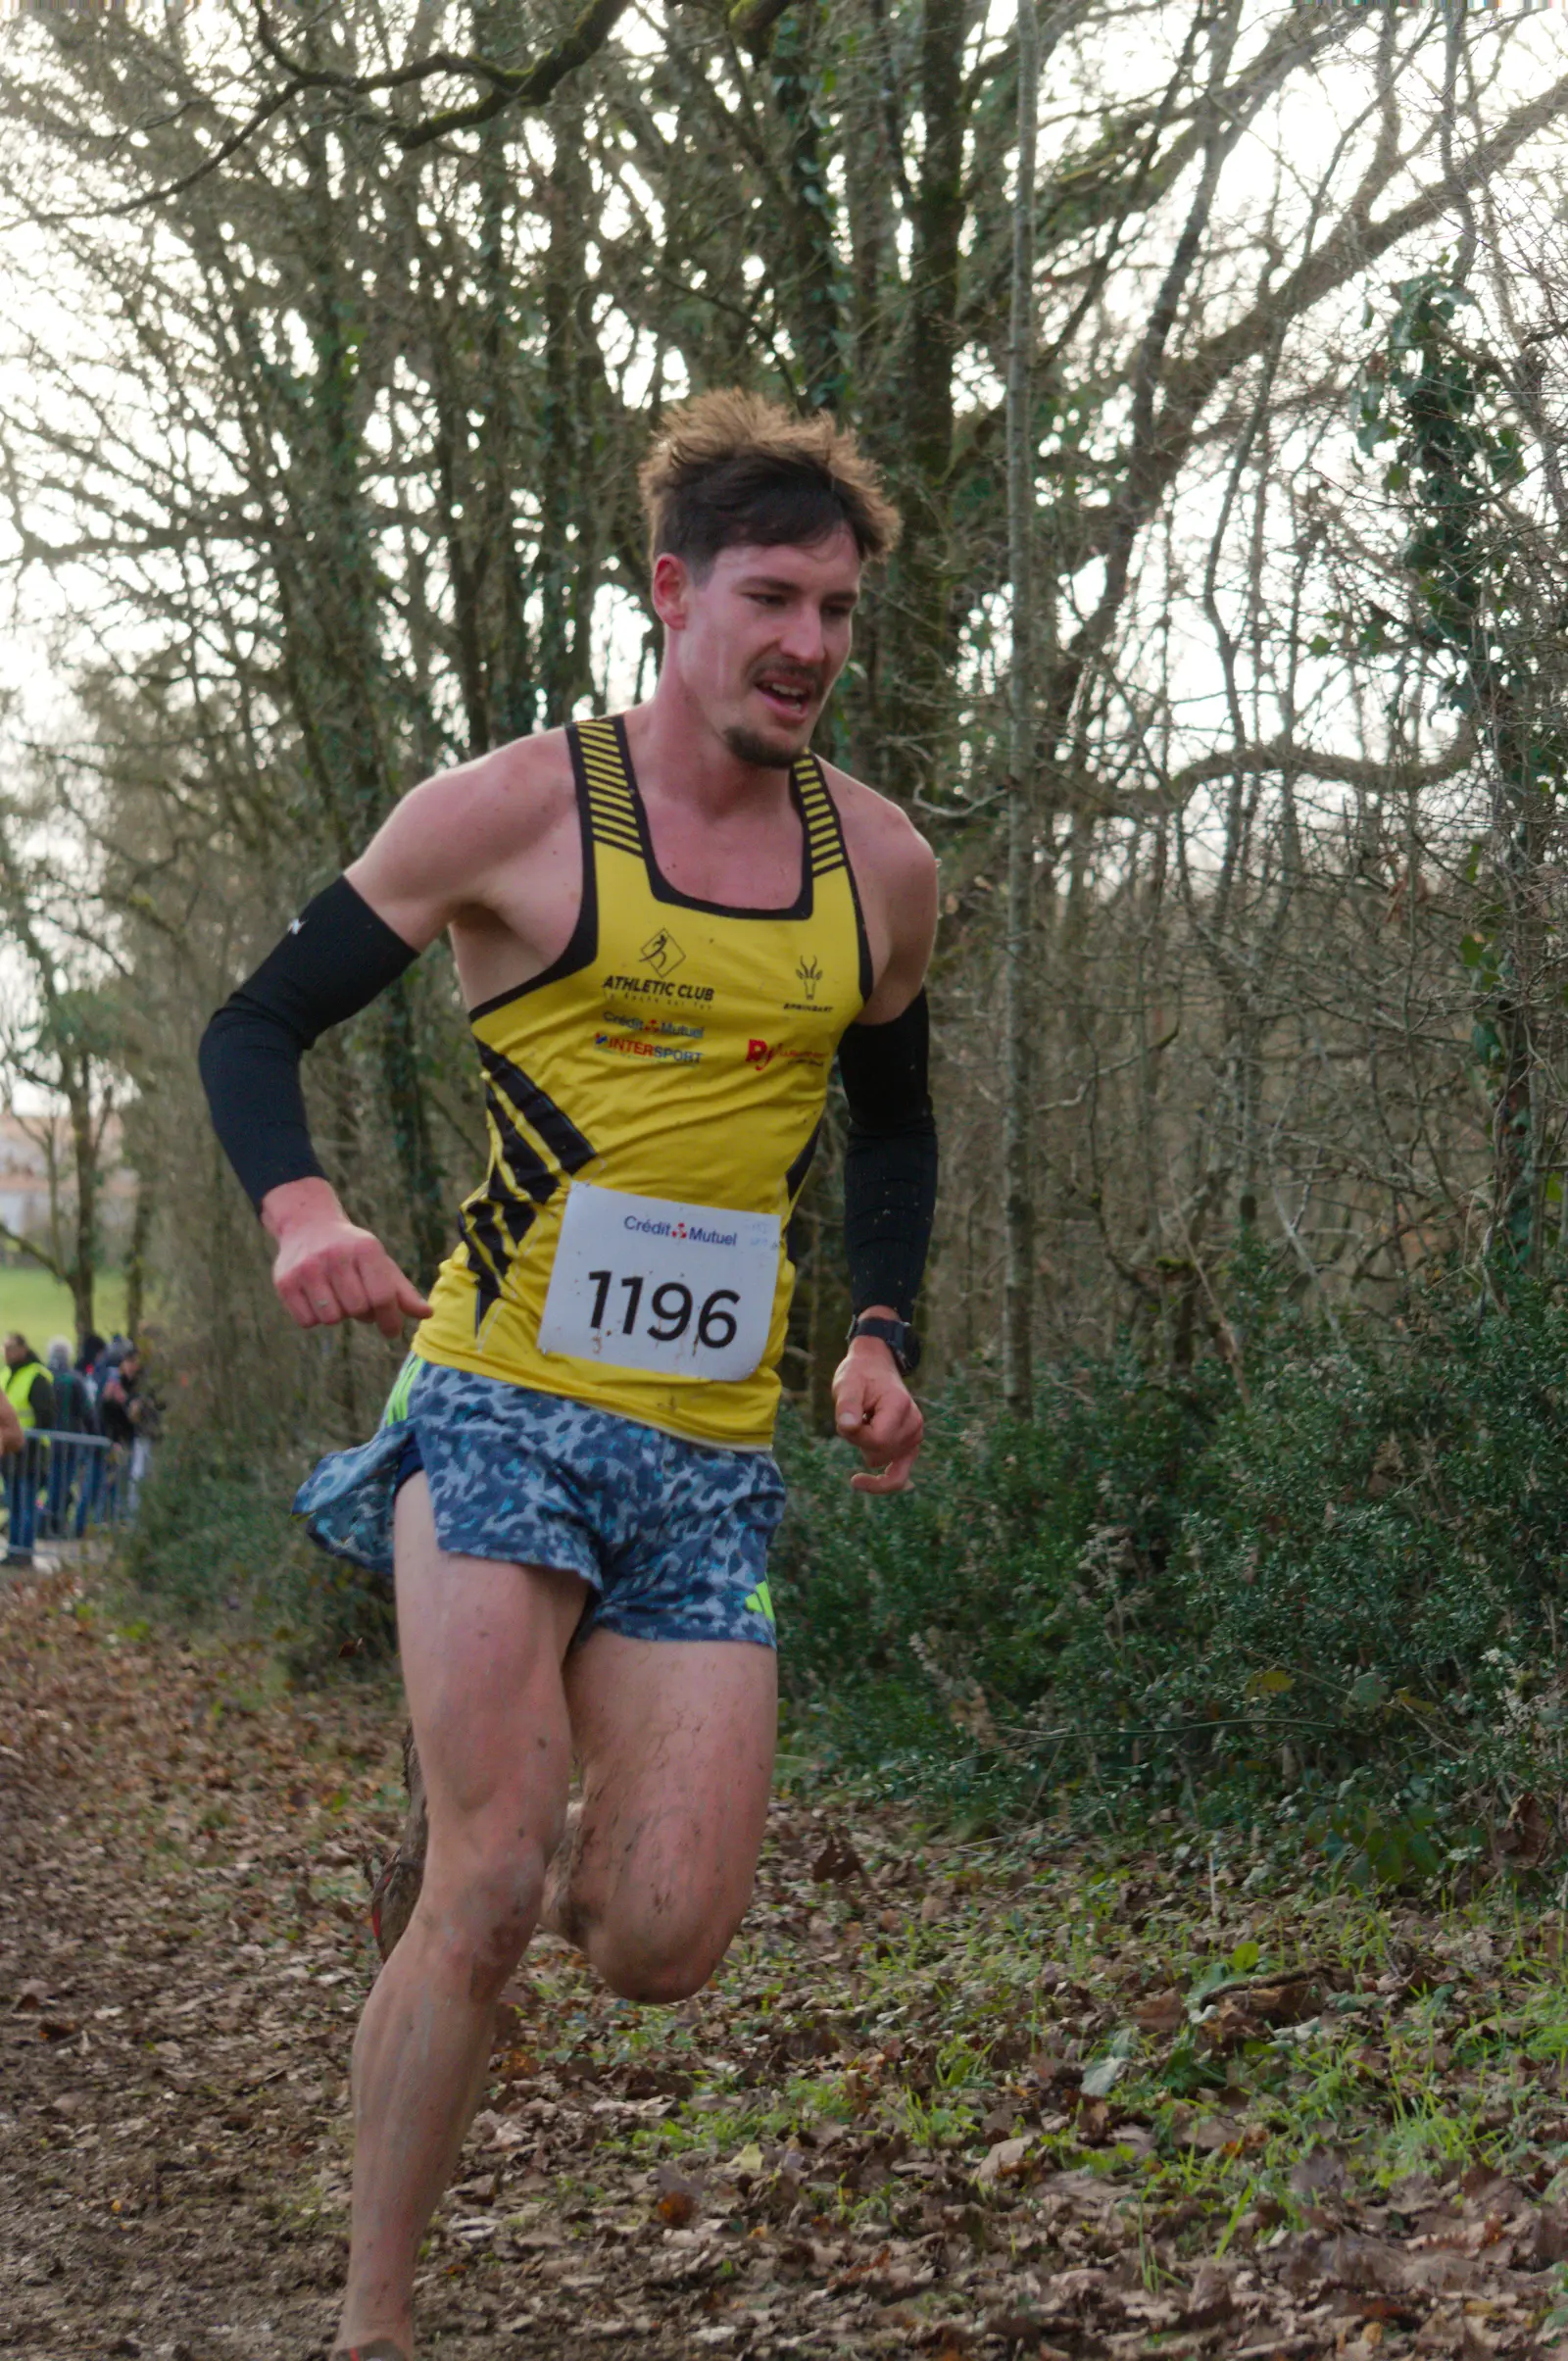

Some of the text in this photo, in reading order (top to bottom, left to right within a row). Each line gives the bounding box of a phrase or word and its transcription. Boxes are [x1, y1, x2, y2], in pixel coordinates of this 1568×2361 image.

[602, 975, 676, 997] ATHLETIC
[677, 984, 715, 1002] CLUB
[608, 1037, 704, 1064] INTERSPORT
[623, 1215, 670, 1237] Crédit
[688, 1226, 738, 1247] Mutuel
[588, 1269, 742, 1349] 1196
